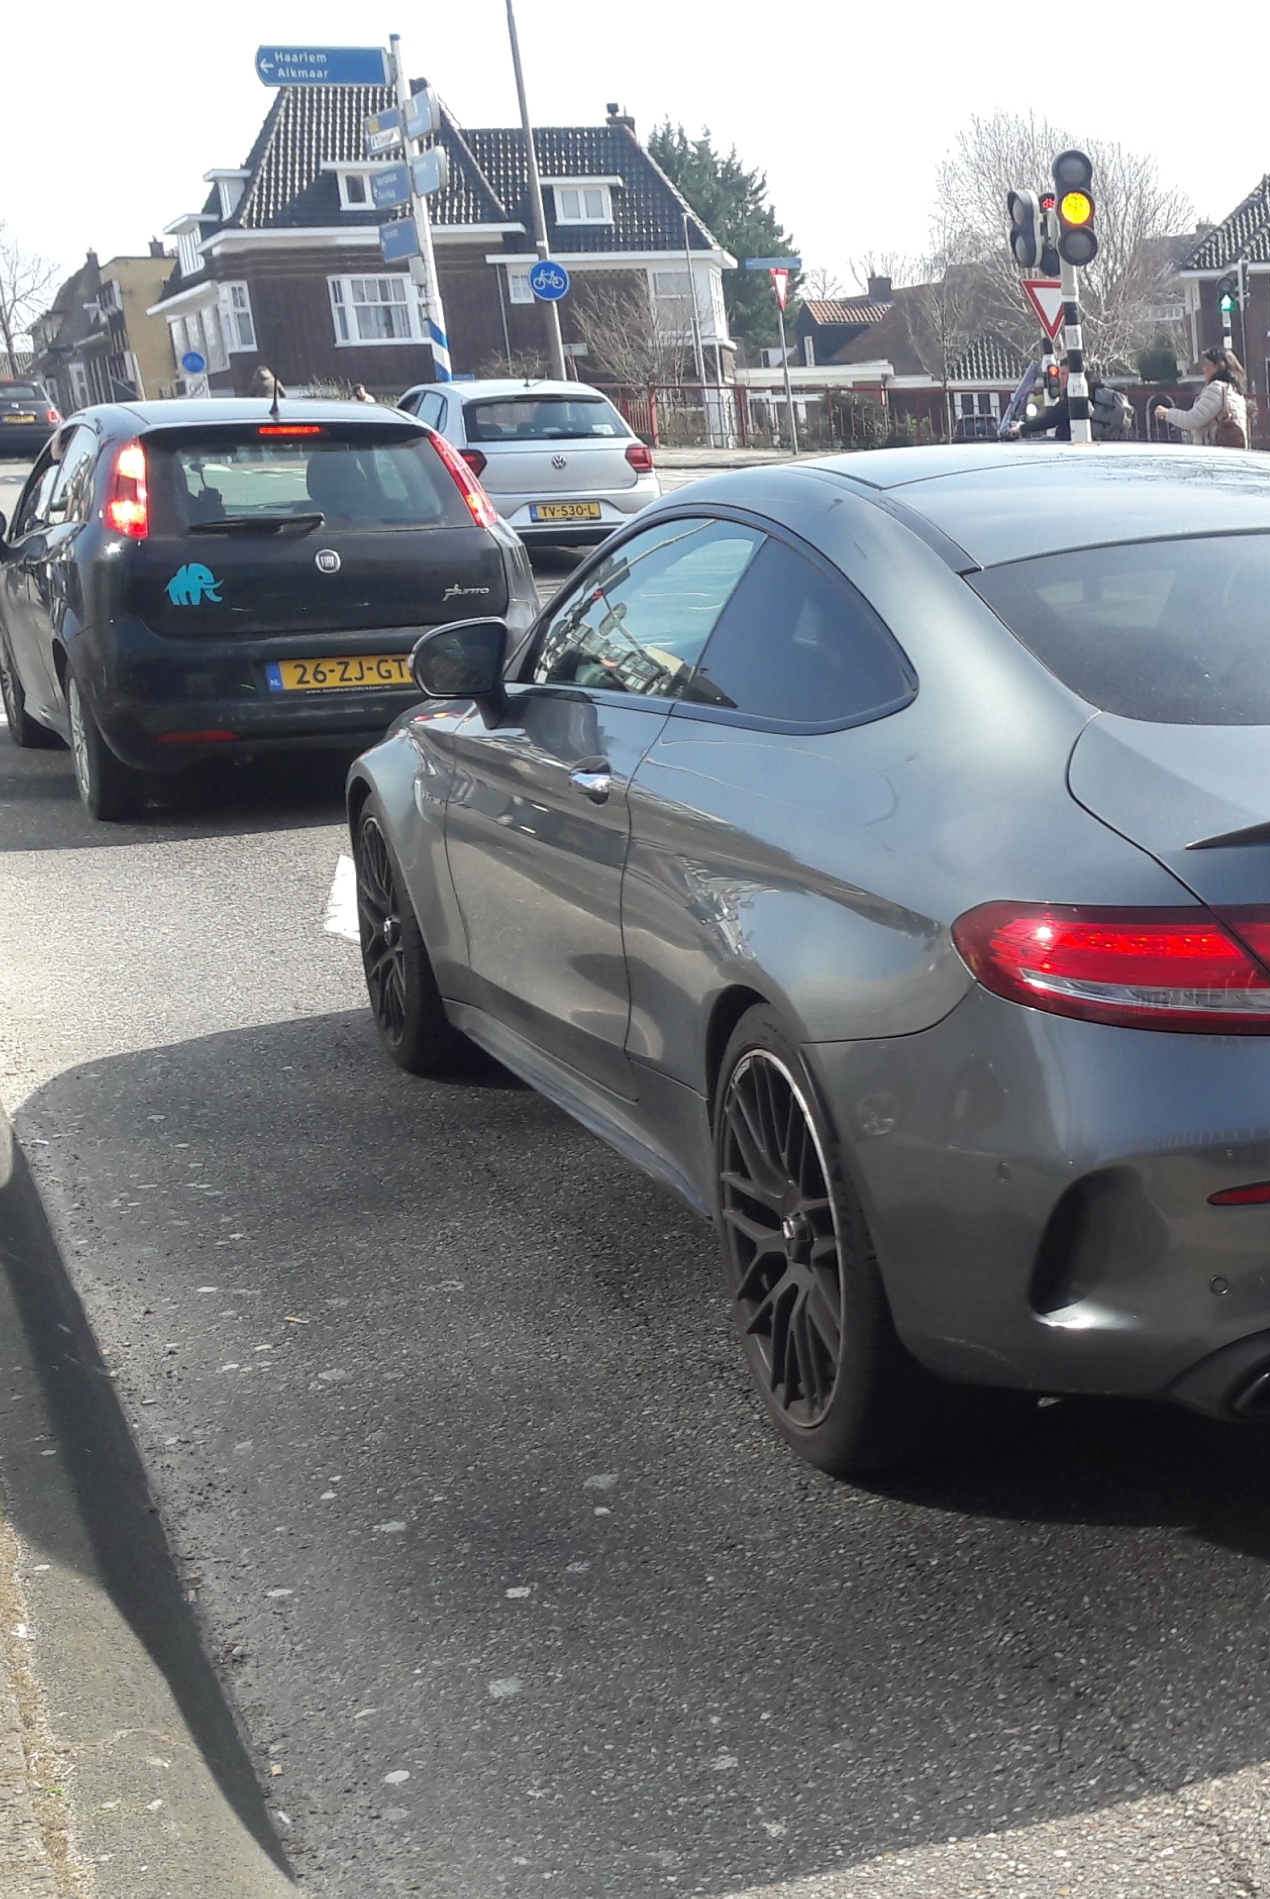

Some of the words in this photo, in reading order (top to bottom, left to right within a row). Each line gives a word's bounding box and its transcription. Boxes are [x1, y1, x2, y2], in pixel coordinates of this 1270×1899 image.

[274, 51, 327, 63] Haarlem
[277, 67, 328, 79] Alkmaar
[541, 504, 596, 517] TV-530-L
[320, 555, 335, 568] FIAT
[270, 678, 281, 687] NL
[294, 657, 406, 685] 26-ZJ-GT
